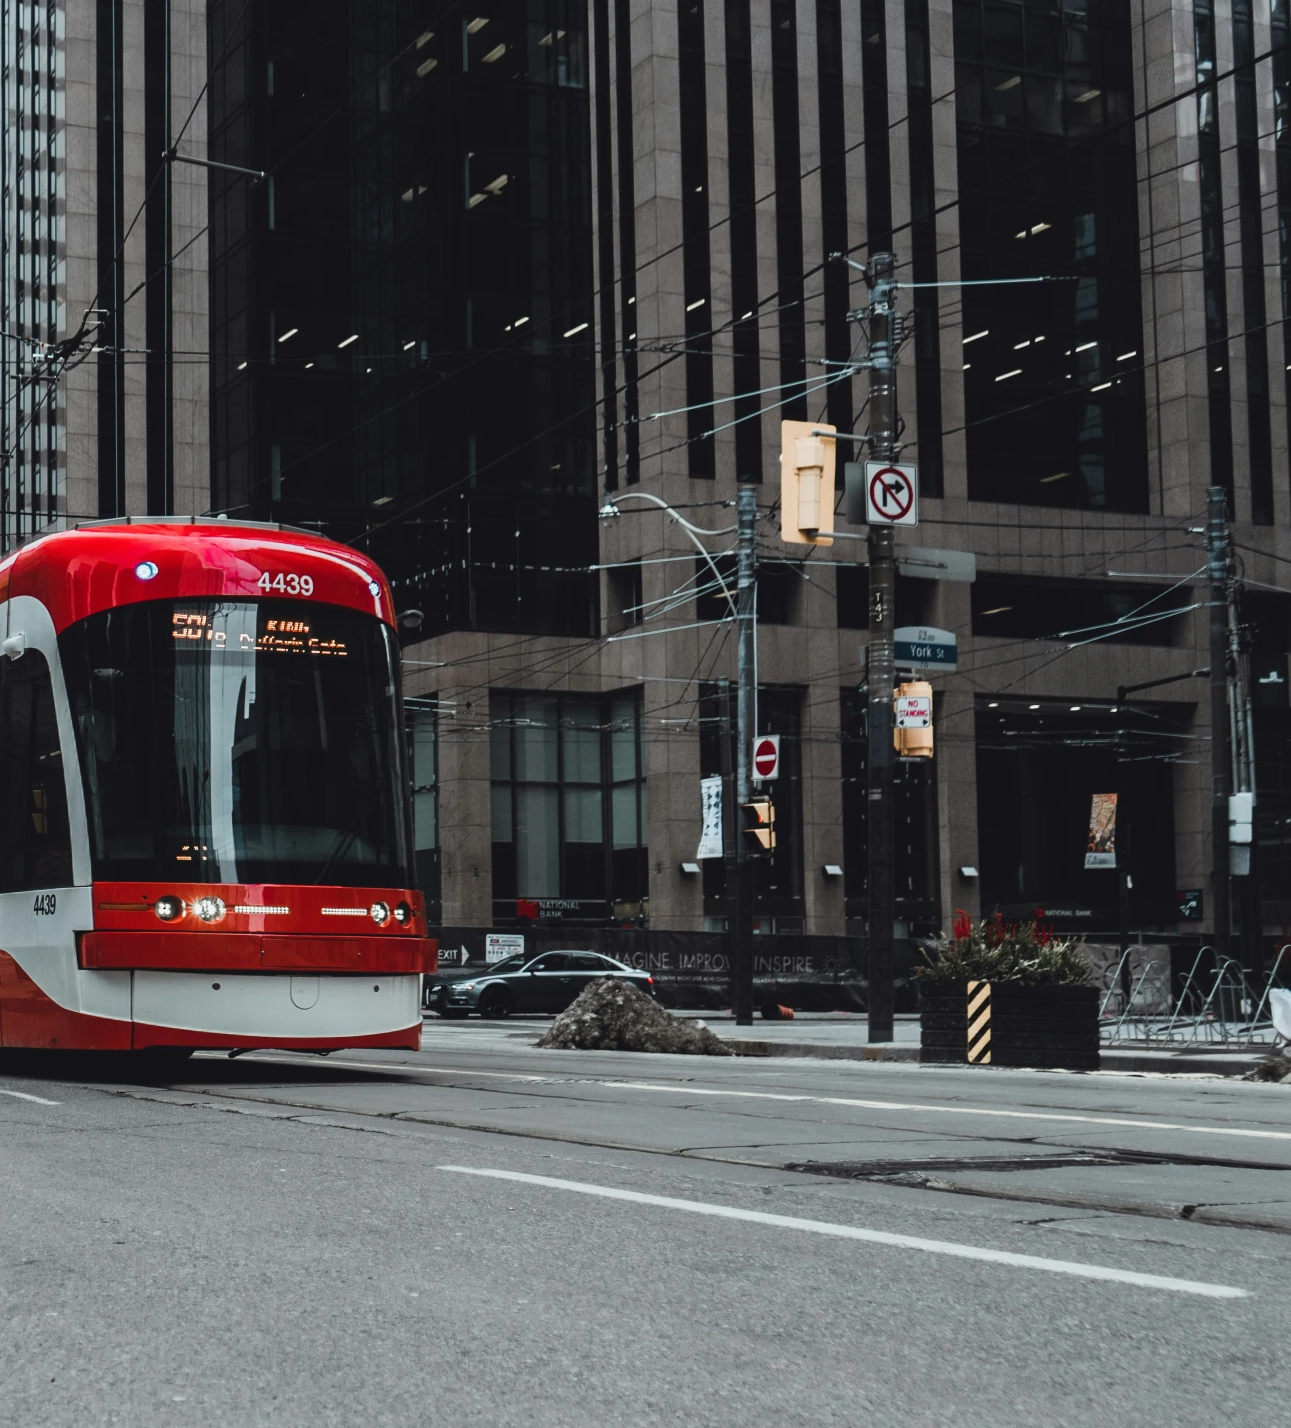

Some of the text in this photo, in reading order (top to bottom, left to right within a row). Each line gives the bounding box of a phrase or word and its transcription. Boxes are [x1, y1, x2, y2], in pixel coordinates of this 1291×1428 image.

[257, 571, 314, 596] 4439
[910, 644, 944, 659] York St
[907, 700, 919, 708] NO
[898, 709, 929, 718] STANDING
[33, 893, 57, 916] 4439
[539, 901, 580, 910] NATIONAL
[539, 910, 563, 918] BANK
[1044, 909, 1092, 917] NATIONAL BANK
[437, 949, 458, 960] EXIT
